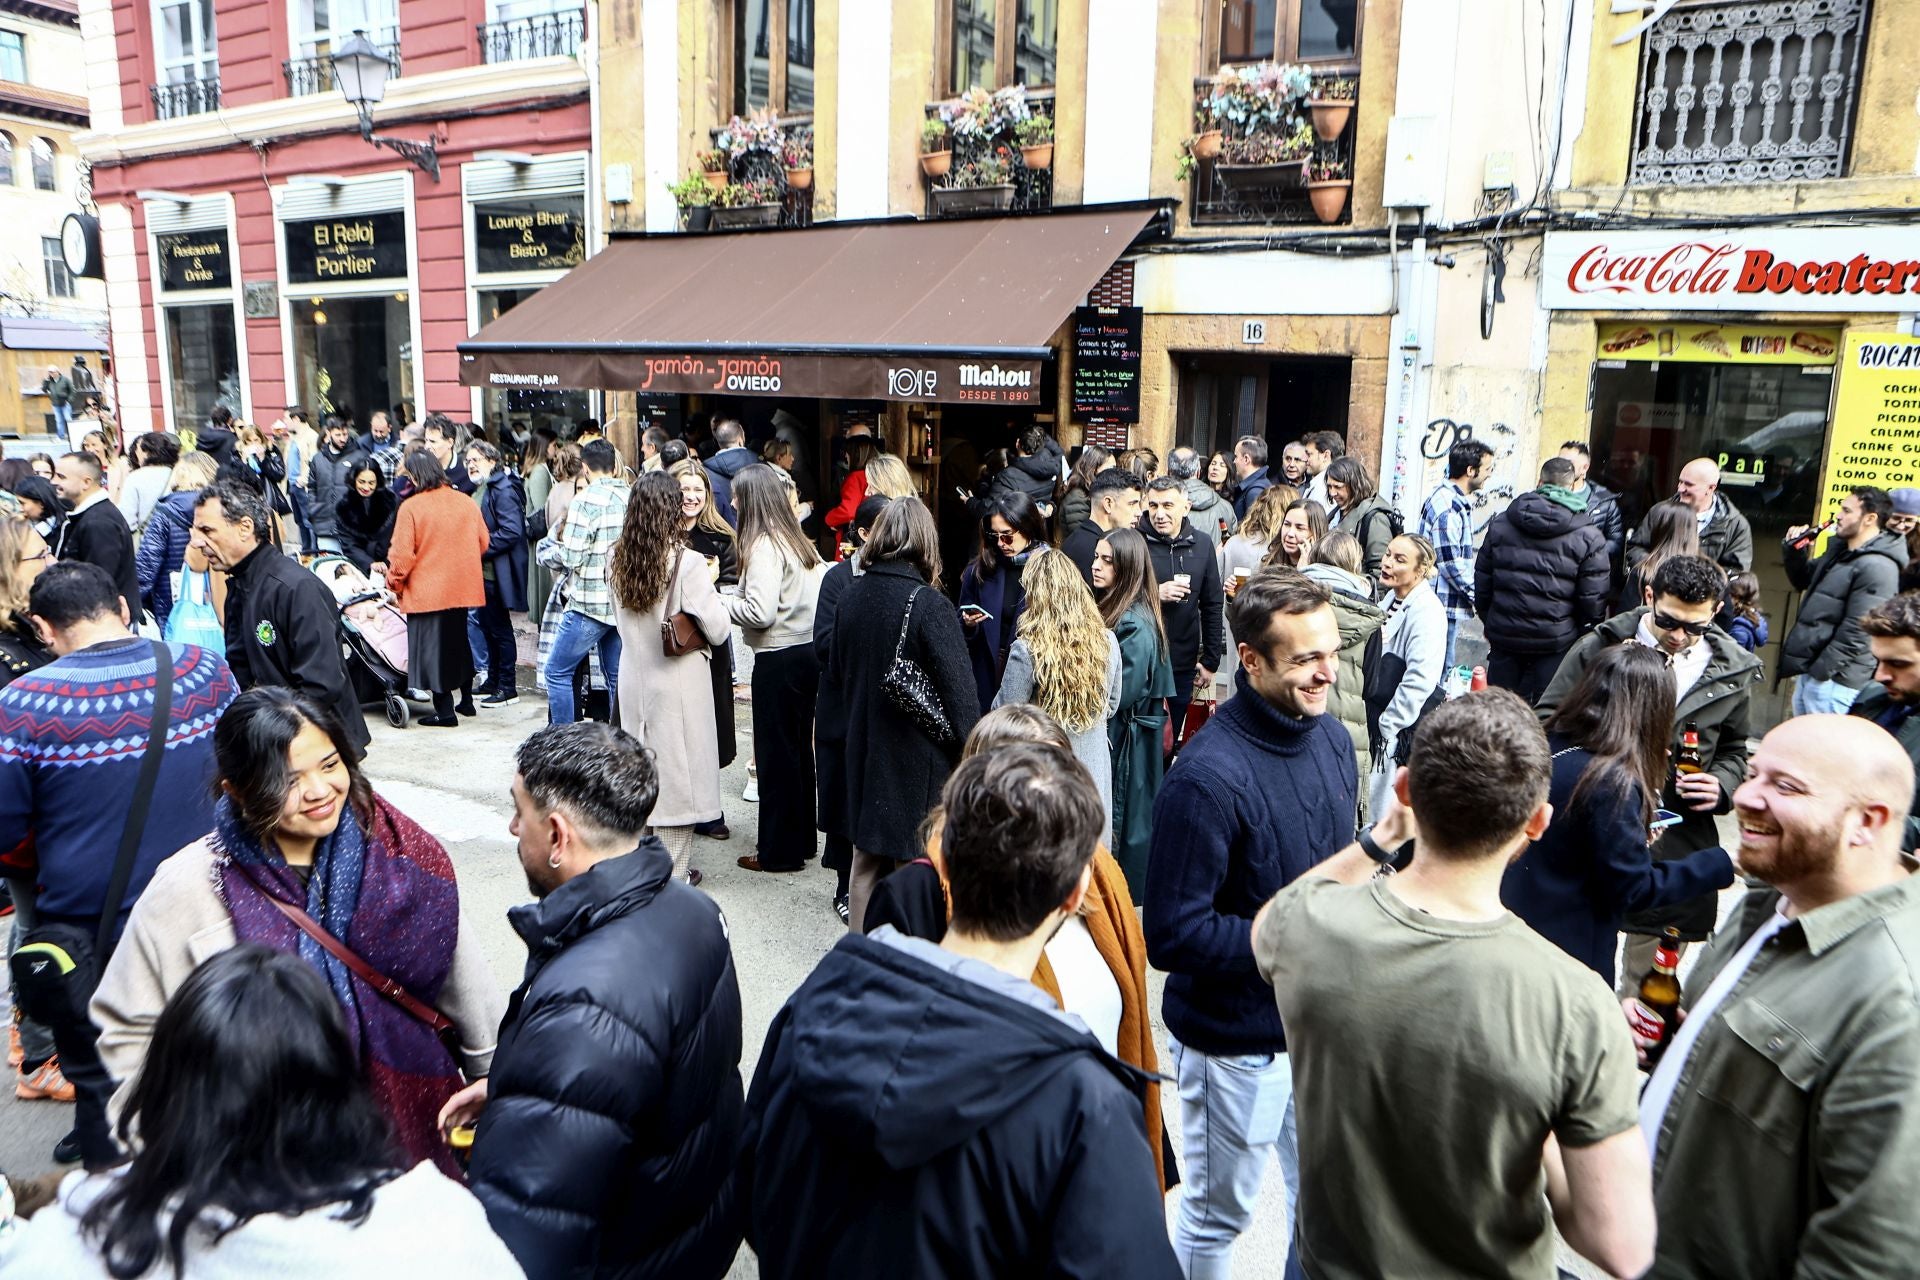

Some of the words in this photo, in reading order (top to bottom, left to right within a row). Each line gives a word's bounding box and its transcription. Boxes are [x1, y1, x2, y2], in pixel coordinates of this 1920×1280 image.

[488, 214, 534, 231] Lounge
[536, 210, 569, 226] Bhar
[314, 224, 330, 246] El
[333, 220, 374, 246] Reloj
[522, 228, 534, 244] &
[172, 242, 222, 258] Restaurant
[335, 242, 349, 255] de
[193, 256, 204, 270] &
[316, 254, 377, 276] Porlier
[1567, 242, 1743, 294] Coca-Cola
[184, 268, 214, 282] Drinks
[1246, 323, 1262, 340] 16
[490, 373, 538, 384] RESTAURANTE
[544, 374, 558, 384] BAR
[959, 364, 1031, 386] Mahou
[727, 375, 781, 392] OVIEDO
[1884, 384, 1920, 394] CACH
[960, 390, 996, 400] DESDE
[1002, 391, 1029, 400] 1890
[1884, 399, 1920, 408] TORT
[1852, 442, 1894, 452] CARNE
[1718, 452, 1764, 474] Pan
[1843, 456, 1902, 467] CHORIZO
[1912, 459, 1920, 468] C
[1837, 470, 1877, 480] LOMO
[1886, 472, 1914, 482] CON
